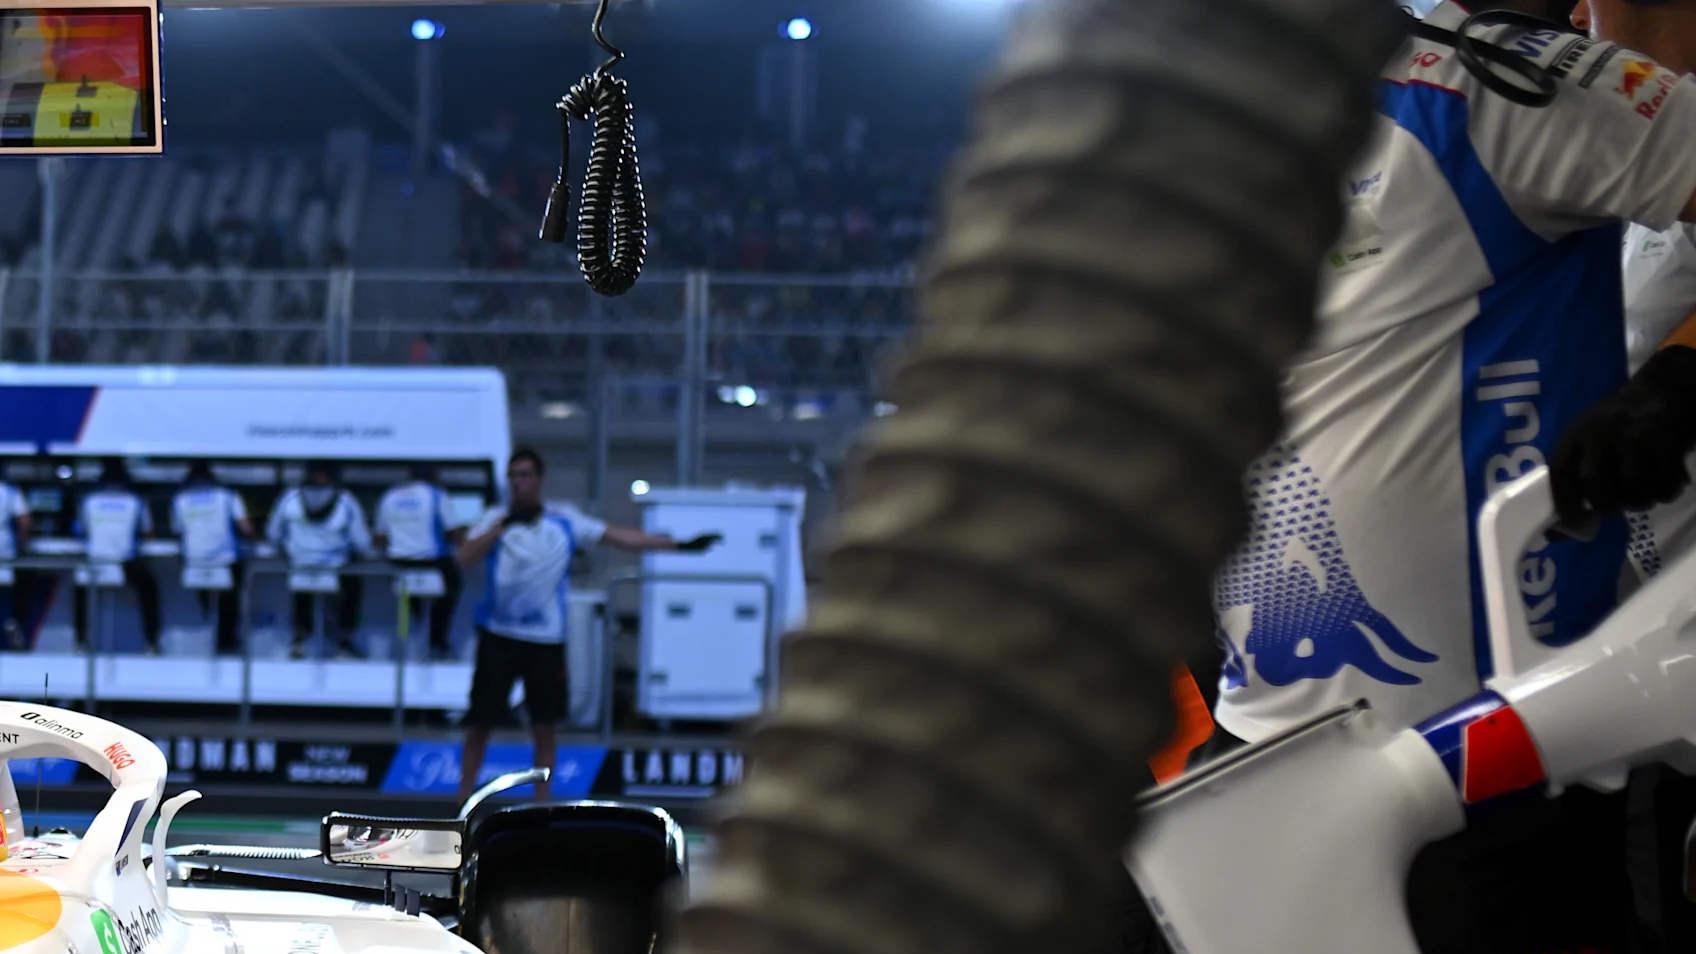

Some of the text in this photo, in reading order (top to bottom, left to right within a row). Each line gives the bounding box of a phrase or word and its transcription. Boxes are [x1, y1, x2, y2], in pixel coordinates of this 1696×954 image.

[1508, 31, 1560, 58] VIS
[1475, 358, 1547, 499] Bull
[34, 716, 85, 741] alinma
[104, 741, 136, 771] HUGO
[154, 736, 277, 773] DMAN
[622, 749, 744, 786] LANDM
